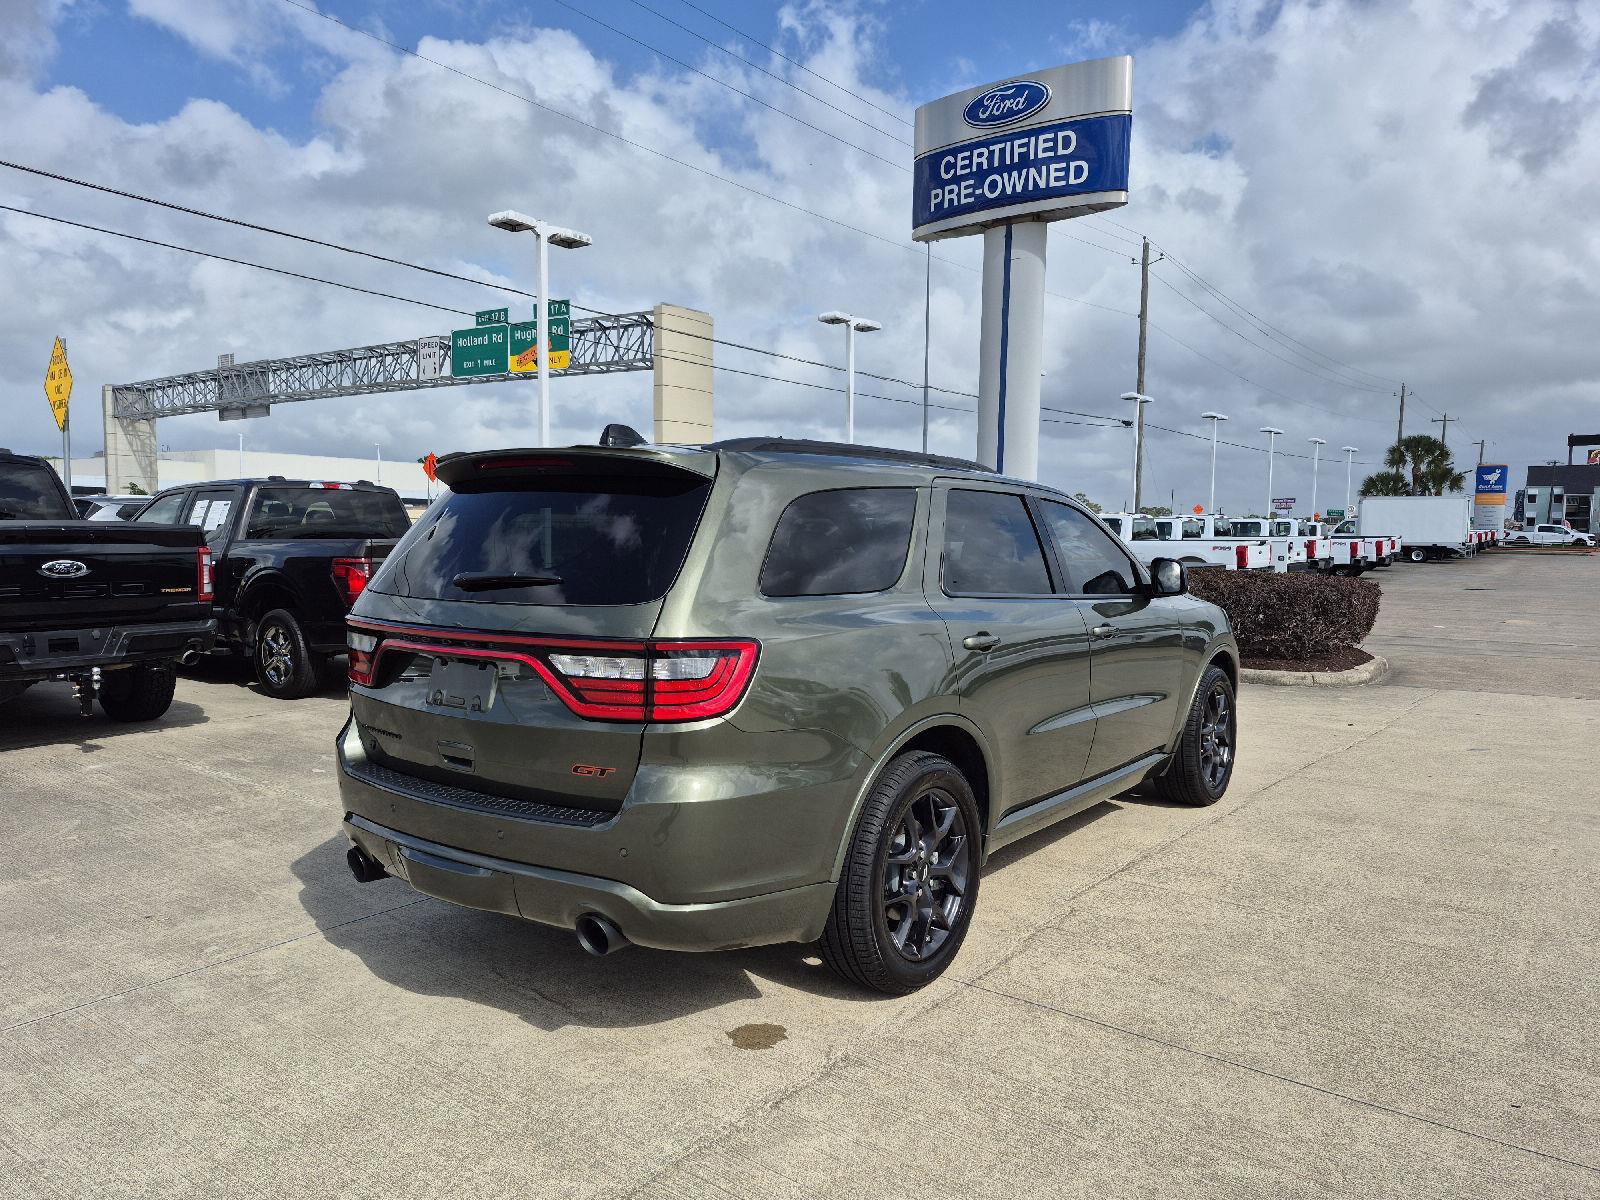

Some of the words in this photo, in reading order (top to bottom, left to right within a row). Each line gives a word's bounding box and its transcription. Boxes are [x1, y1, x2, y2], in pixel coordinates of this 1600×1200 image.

[979, 87, 1028, 119] Ford
[940, 130, 1077, 180] CERTIFIED
[930, 160, 1089, 212] PRE-OWNED
[550, 304, 558, 314] 17
[561, 303, 567, 313] A
[457, 335, 489, 348] Holland
[492, 332, 503, 343] Rd
[514, 329, 538, 342] Hugh
[552, 324, 564, 335] Rd
[420, 341, 439, 350] SPEED
[549, 356, 562, 365] NLY
[53, 563, 77, 573] Ford
[571, 762, 616, 777] GT
